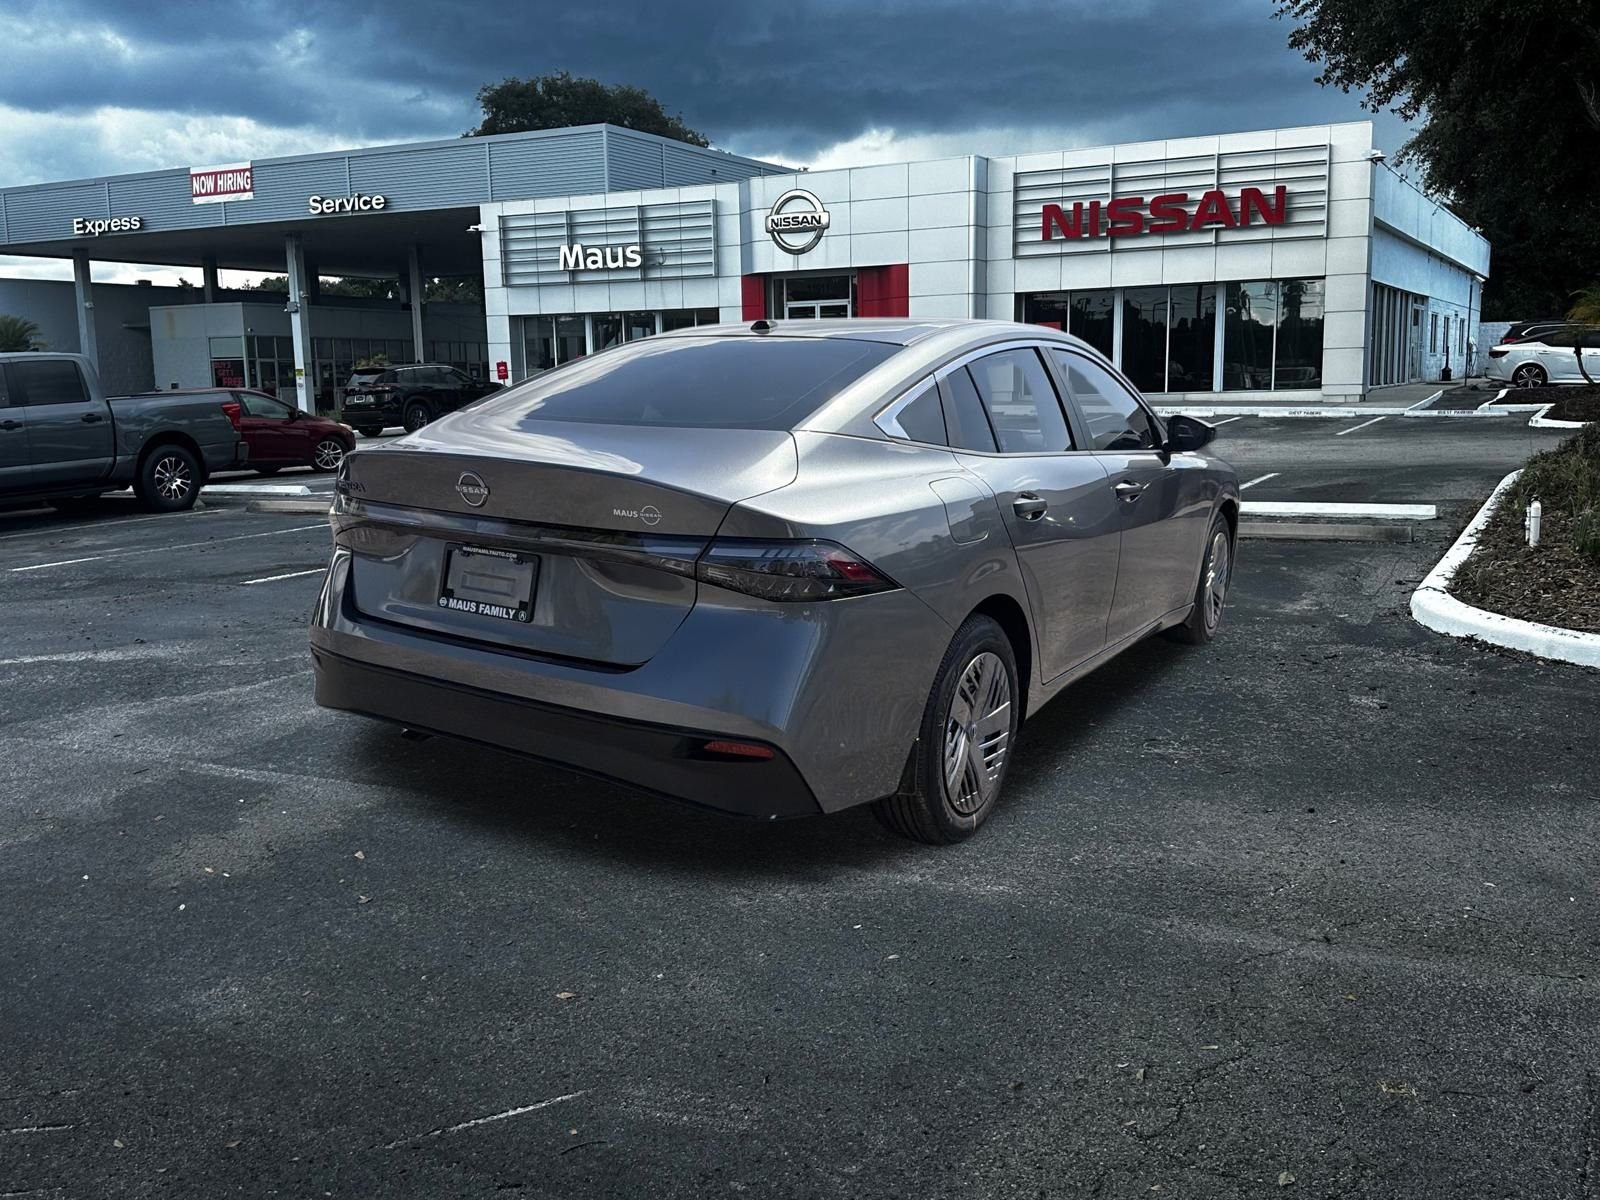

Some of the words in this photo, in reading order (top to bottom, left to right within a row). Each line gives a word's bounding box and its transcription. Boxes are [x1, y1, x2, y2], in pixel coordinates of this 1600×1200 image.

[192, 175, 214, 195] NOW
[217, 171, 251, 192] HIRING
[308, 193, 386, 215] Service
[1042, 185, 1287, 241] NISSAN
[72, 215, 141, 236] Express
[769, 214, 822, 230] NISSAN
[559, 243, 642, 271] Maus
[455, 485, 490, 496] NISSAN
[613, 508, 639, 518] MAUS
[448, 598, 477, 613] MAUS
[478, 604, 517, 620] FAMILY
